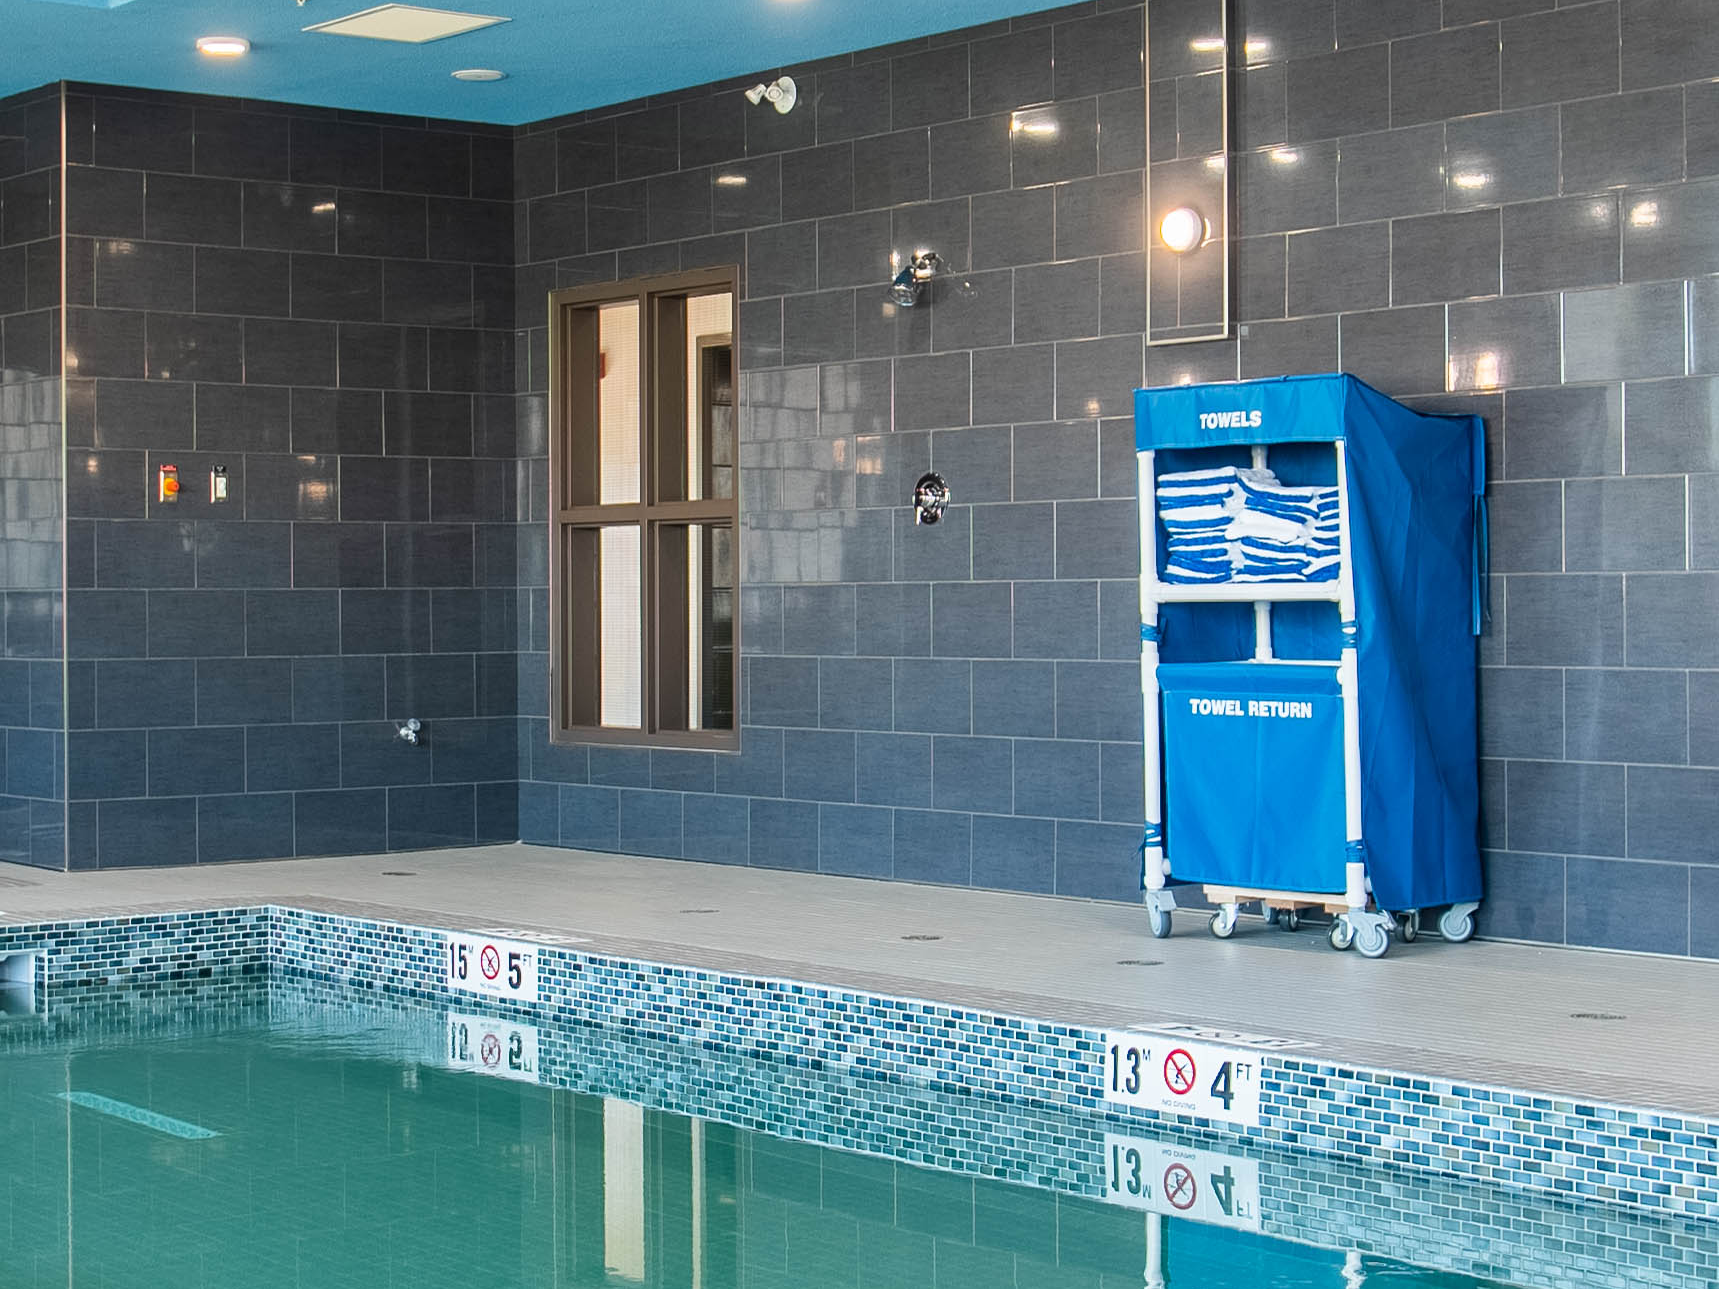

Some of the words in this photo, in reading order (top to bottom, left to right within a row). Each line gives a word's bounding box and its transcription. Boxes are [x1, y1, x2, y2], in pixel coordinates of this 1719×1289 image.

[1200, 410, 1262, 429] TOWELS
[1189, 698, 1244, 718] TOWEL
[1248, 700, 1313, 718] RETURN
[508, 951, 522, 990] 5
[523, 954, 532, 968] FT
[1142, 1048, 1151, 1061] M
[1211, 1061, 1235, 1111] 4
[1236, 1063, 1252, 1082] FT
[1161, 1098, 1172, 1106] NO
[1173, 1101, 1196, 1111] DIVING
